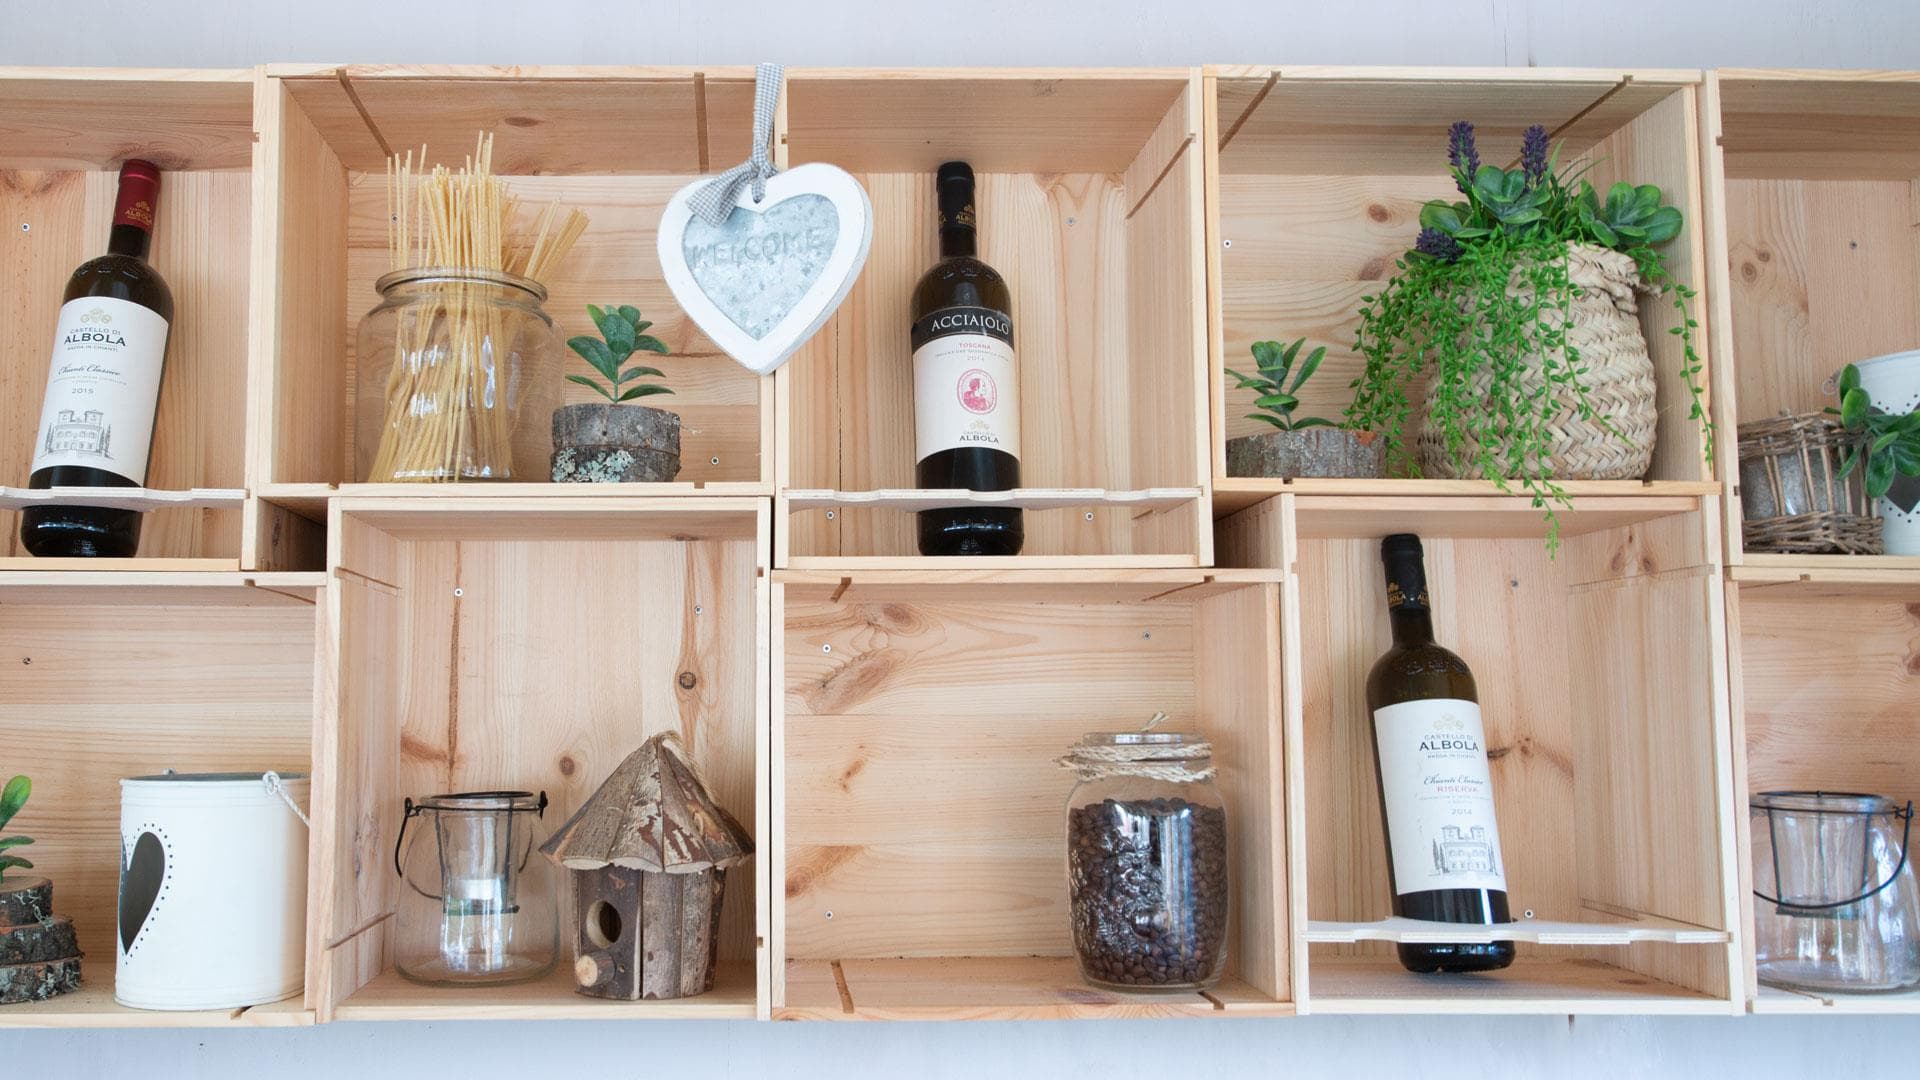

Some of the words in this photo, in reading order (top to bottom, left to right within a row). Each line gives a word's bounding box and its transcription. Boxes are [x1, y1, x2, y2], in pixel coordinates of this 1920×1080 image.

[691, 227, 830, 266] WELCOME
[931, 314, 1009, 335] ACCIAIOLO
[64, 332, 126, 347] ALBOLA
[959, 342, 991, 350] TOSCANA
[959, 434, 999, 444] ALBOLA
[1419, 740, 1480, 752] ALBOLA
[1437, 785, 1478, 793] RISERVA
